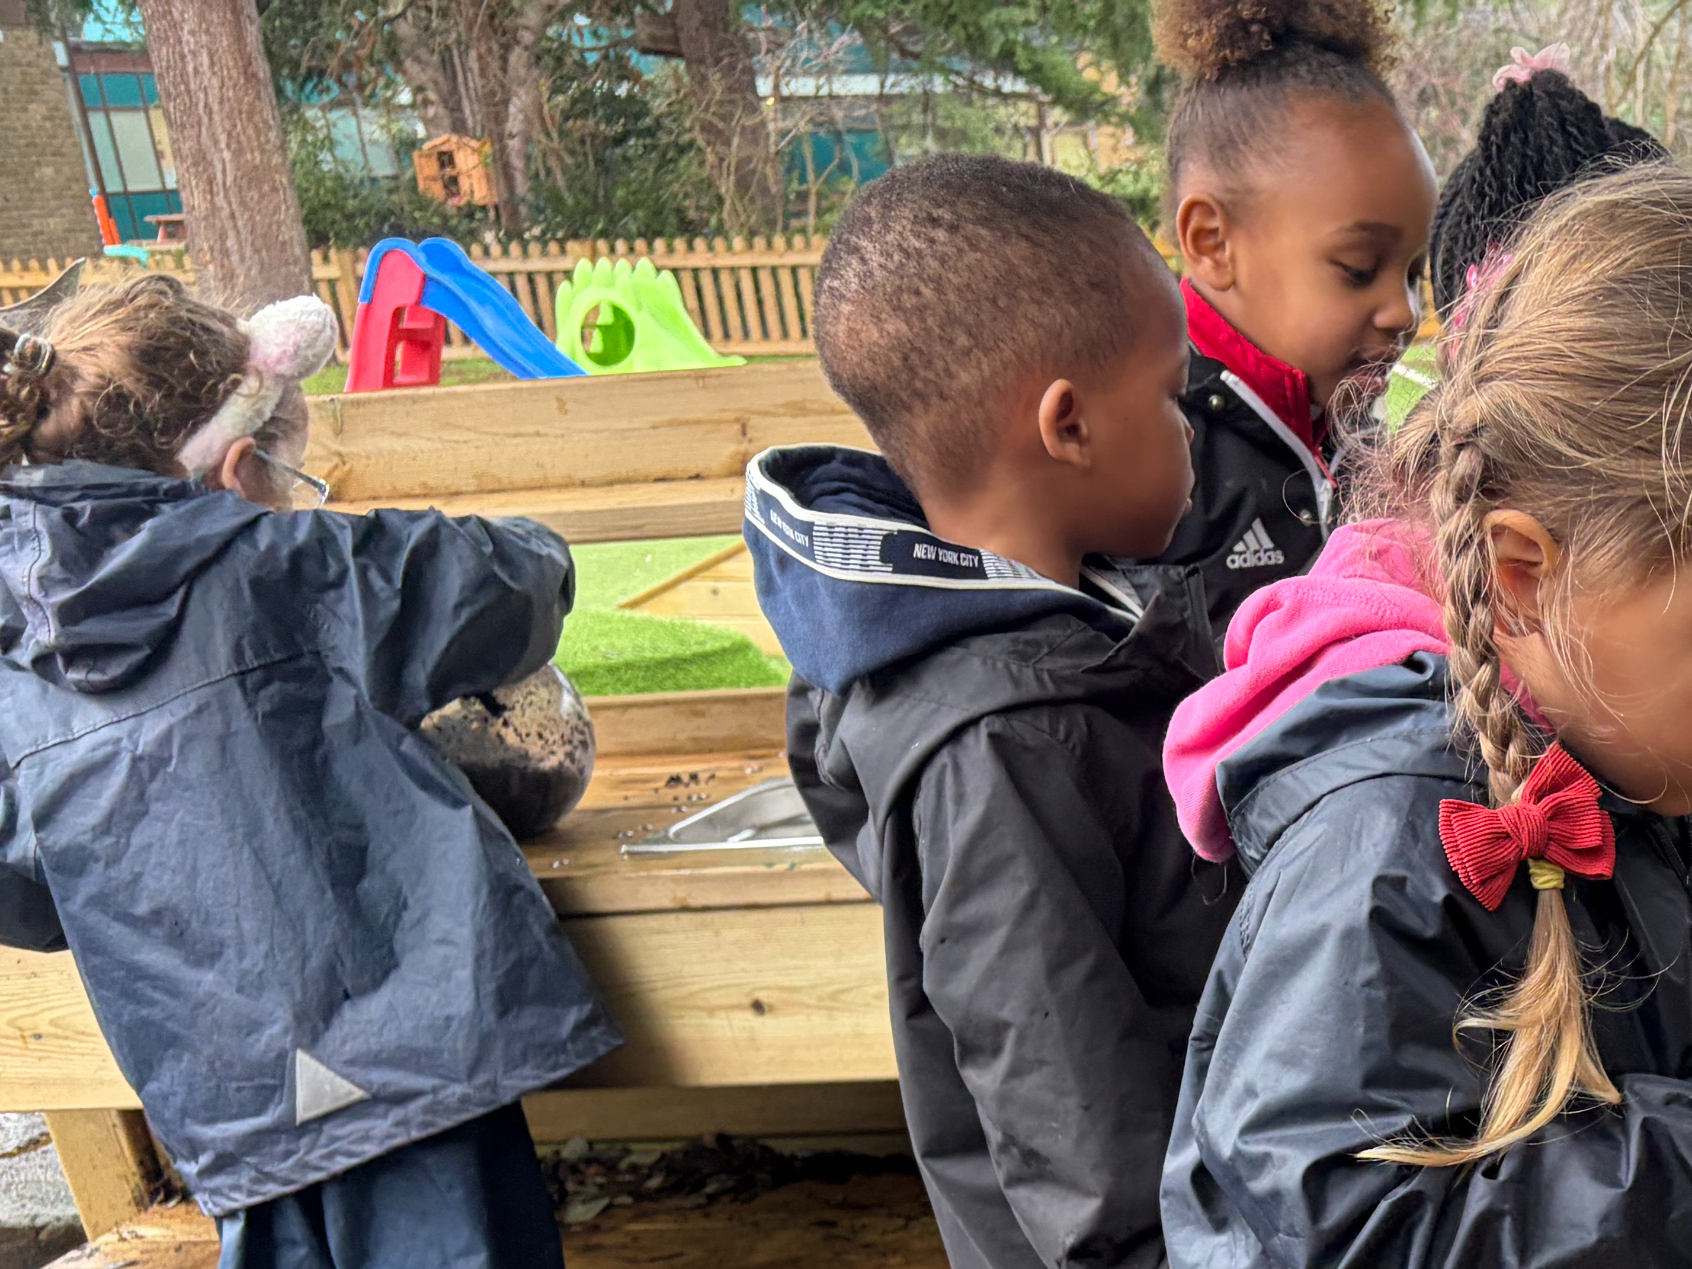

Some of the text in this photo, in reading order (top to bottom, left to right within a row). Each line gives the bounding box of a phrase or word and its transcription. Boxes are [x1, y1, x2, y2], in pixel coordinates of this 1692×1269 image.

[913, 543, 979, 568] NEW YORK CITY
[1226, 549, 1285, 570] adidas
